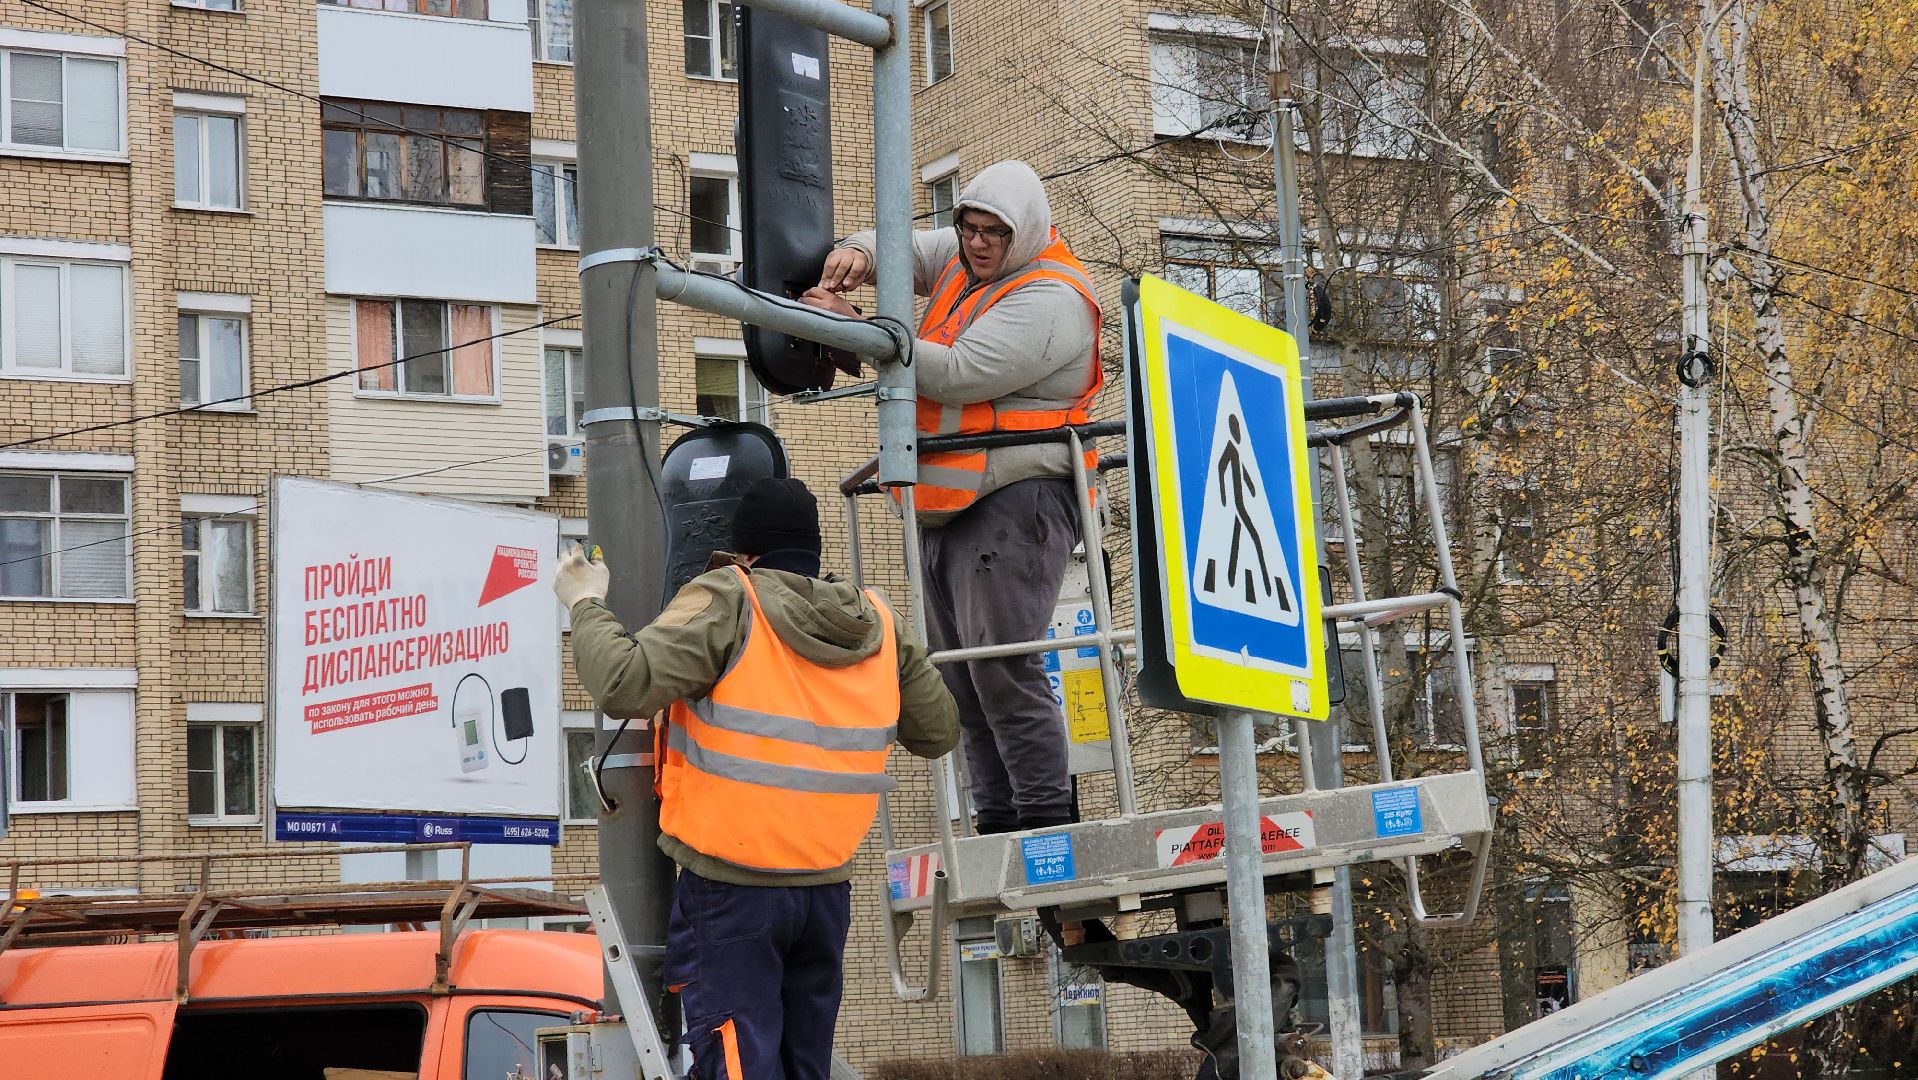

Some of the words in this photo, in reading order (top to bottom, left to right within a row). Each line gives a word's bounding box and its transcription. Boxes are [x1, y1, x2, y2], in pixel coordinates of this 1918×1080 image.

[304, 553, 391, 601] ПРОЙДИ
[513, 558, 537, 570] ПРОЕКТЫ
[517, 568, 537, 579] РОССИИ
[304, 594, 426, 646] БЕСПЛАТНО
[302, 621, 509, 696] ДИСПАНСЕРИЗАЦИЮ
[308, 708, 320, 718] по
[321, 701, 352, 714] закону
[353, 699, 370, 712] для
[372, 694, 396, 706] этого
[398, 687, 429, 702] можно
[313, 709, 375, 731] использовать
[375, 700, 413, 721] рабочий
[415, 699, 437, 714] день
[435, 825, 453, 835] Russ
